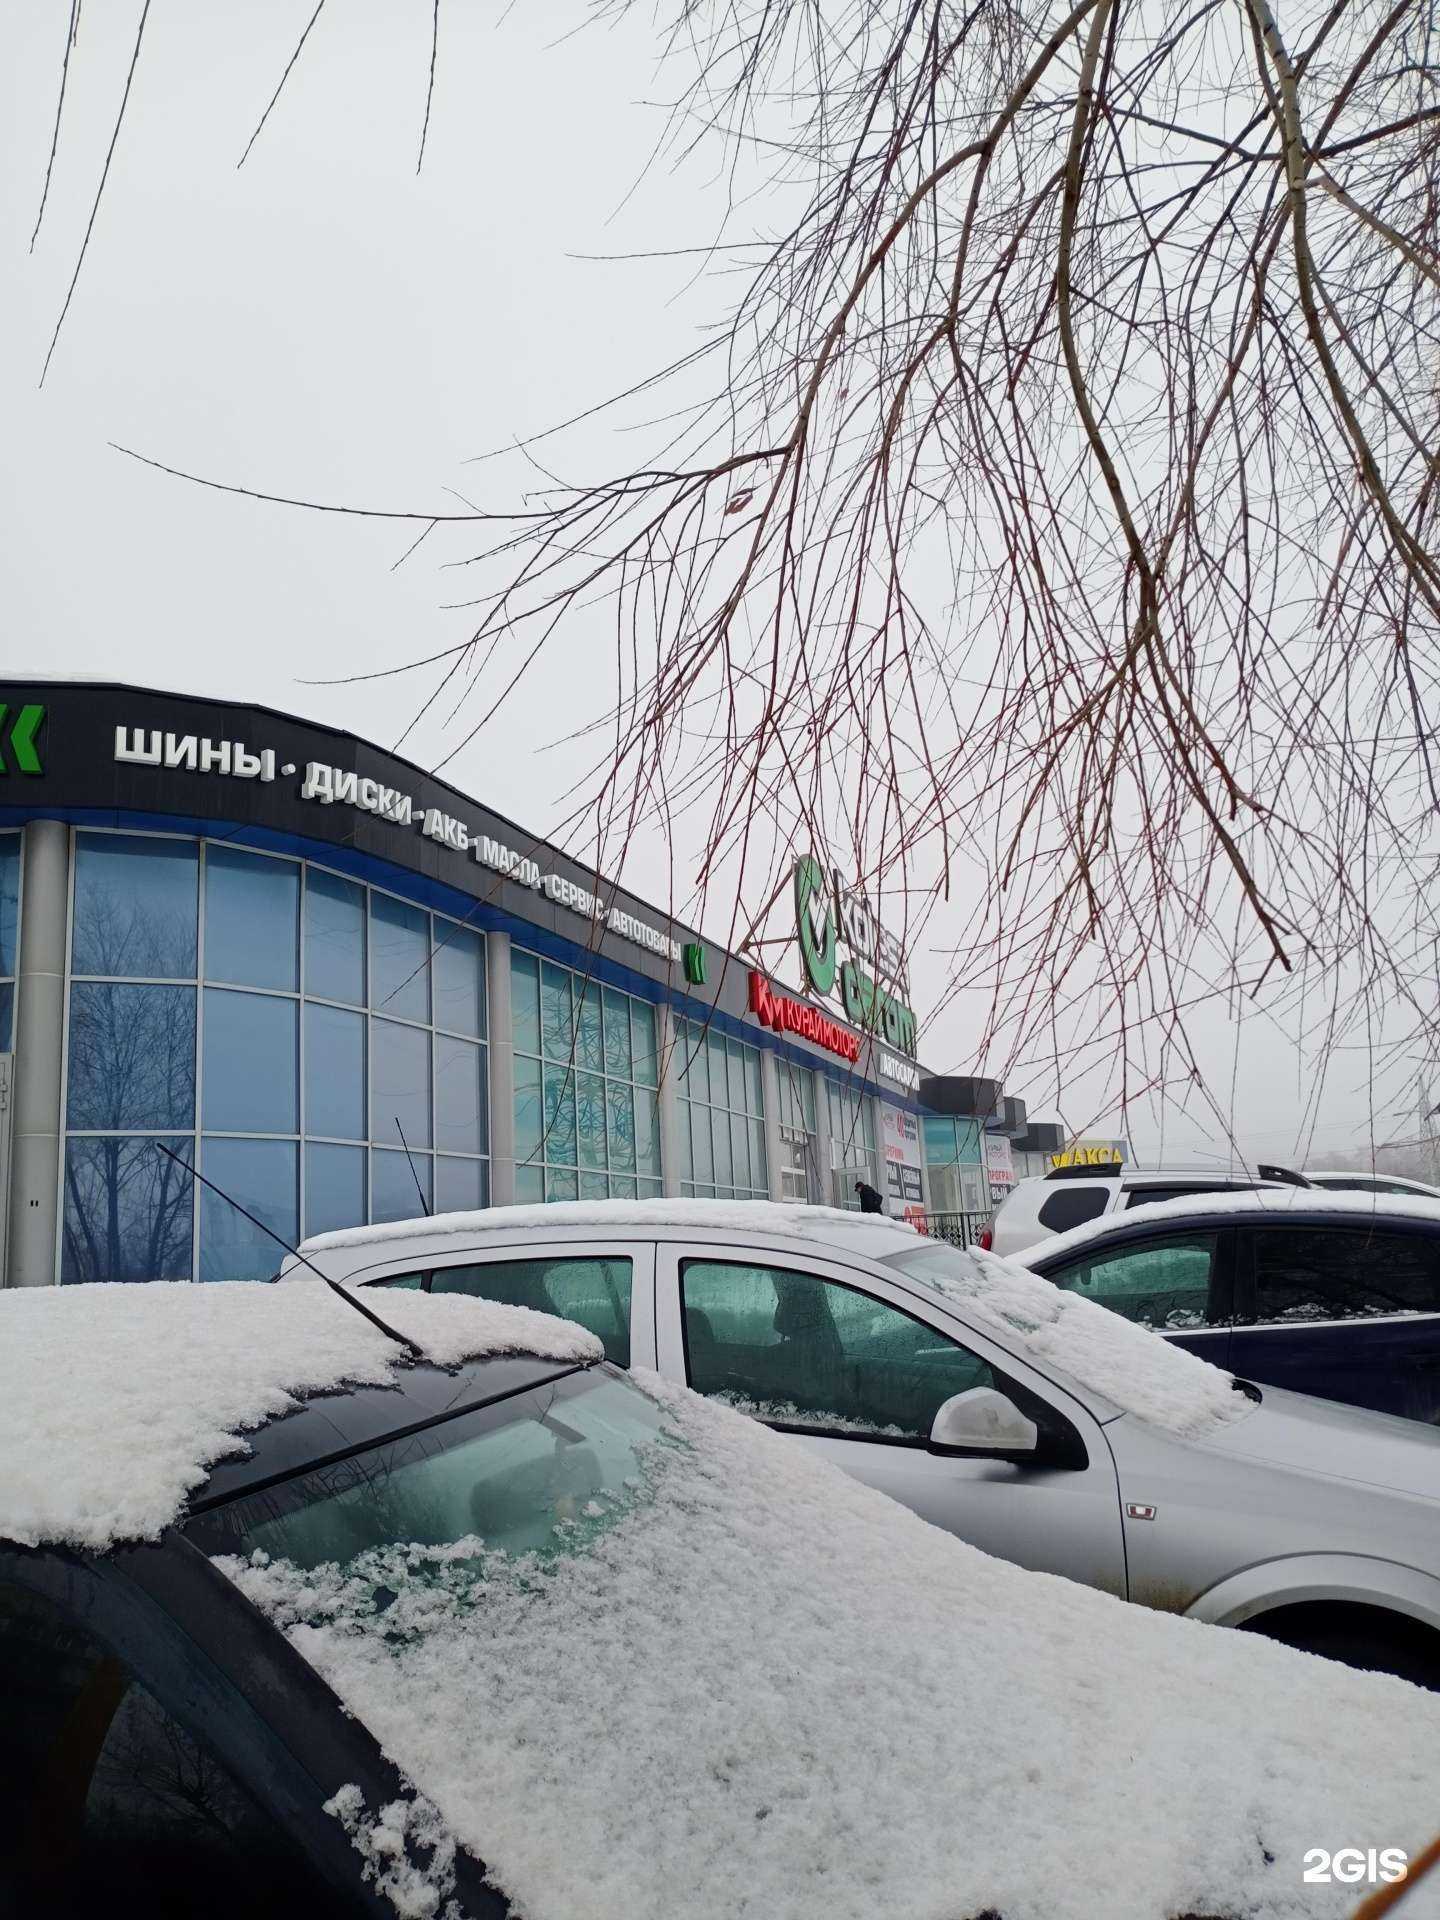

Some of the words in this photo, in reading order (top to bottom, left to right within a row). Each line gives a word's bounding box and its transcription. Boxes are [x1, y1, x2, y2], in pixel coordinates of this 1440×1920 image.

[114, 725, 275, 782] ШИНЫ
[302, 761, 412, 826] ДИСКИ
[422, 808, 468, 851] АКБ
[475, 835, 541, 889] МАСЛА
[546, 873, 605, 922] СЕРВИС
